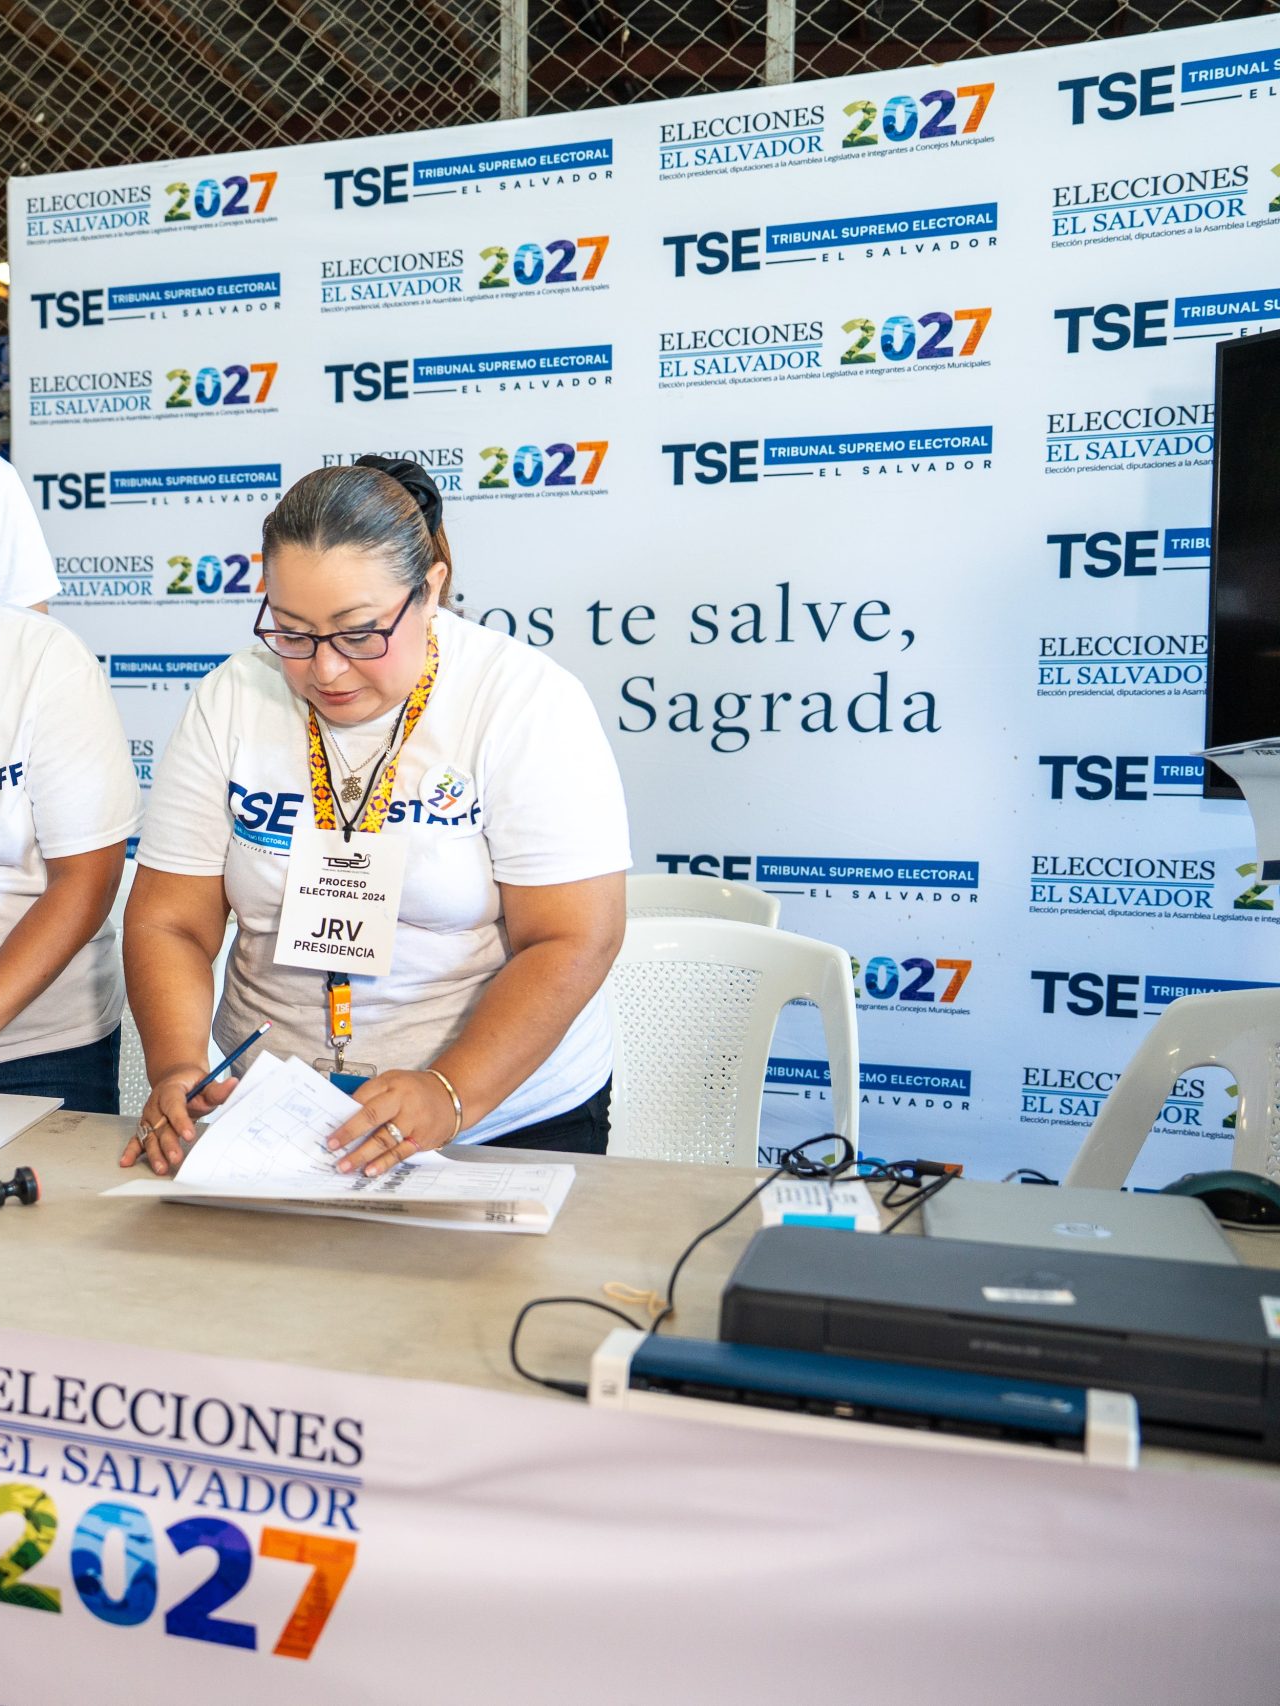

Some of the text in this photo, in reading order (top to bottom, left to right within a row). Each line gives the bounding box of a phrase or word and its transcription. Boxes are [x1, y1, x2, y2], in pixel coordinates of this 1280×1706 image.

[1189, 61, 1269, 82] TRIBUNAL
[1059, 67, 1174, 123] TSE
[1250, 86, 1276, 99] EL
[660, 105, 824, 143] ELECCIONES
[843, 84, 994, 147] 2027
[418, 148, 609, 178] TRIBUNAL SUPREMO ELECTORAL
[659, 172, 685, 180] Elección
[687, 167, 728, 178] presidencial,
[730, 163, 773, 173] diputaciones
[788, 157, 822, 166] Asamblea
[824, 153, 859, 162] Legislativa
[867, 147, 908, 157] integrantes
[915, 142, 949, 151] Concejos
[950, 136, 994, 146] Municipales
[660, 135, 823, 170] EL SALVADOR
[325, 165, 409, 210] TSE
[462, 170, 612, 194] EL SALVADOR
[1053, 165, 1248, 207] ELECCIONES
[27, 185, 151, 214] ELECCIONES
[165, 173, 277, 221] 2027
[27, 210, 150, 236] EL SALVADOR
[771, 213, 993, 244] TRIBUNAL SUPREMO ELECTORAL
[1053, 198, 1246, 236] EL SALVADOR
[480, 237, 608, 288] 2027
[664, 230, 759, 275] TSE
[822, 236, 997, 262] EL SALVADOR
[322, 249, 463, 278] ELECCIONES
[112, 281, 277, 303] TRIBUNAL SUPREMO ELECTORAL
[322, 276, 462, 303] EL SALVADOR
[31, 290, 104, 329] TSE
[150, 301, 280, 320] EL SALVADOR
[1181, 301, 1259, 318] TRIBUNAL
[660, 321, 823, 351] ELECCIONES
[841, 309, 991, 363] 2027
[1055, 301, 1167, 352] TSE
[418, 354, 608, 375] TRIBUNAL SUPREMO ELECTORAL
[660, 350, 822, 377] EL SALVADOR
[30, 370, 152, 393] ELECCIONES
[166, 364, 277, 407] 2027
[325, 361, 409, 403] TSE
[462, 376, 611, 393] EL SALVADOR
[30, 395, 151, 416] EL SALVADOR
[769, 436, 987, 457] TRIBUNAL SUPREMO ELECTORAL
[1046, 444, 1078, 462] EL
[479, 442, 607, 487] 2027
[663, 442, 757, 483] TSE
[819, 460, 991, 477] EL SALVADOR
[34, 472, 106, 510] TSE
[114, 470, 277, 487] TRIBUNAL SUPREMO ELECTORAL
[151, 492, 284, 506] EL SALVADOR
[1046, 530, 1158, 579] TSE
[586, 600, 655, 645] te
[690, 583, 914, 651] salve,
[115, 662, 215, 672] TRIBUNAL SUPREMO
[1038, 667, 1070, 685] EL
[619, 671, 941, 750] Sagrada
[1038, 755, 1148, 799] TSE
[762, 865, 974, 880] TRIBUNAL SUPREMO ELECTORAL
[1031, 856, 1215, 880] ELECCIONES
[300, 887, 386, 902] ELECTORAL 2024
[319, 877, 367, 889] PROCESO
[810, 888, 977, 903] EL SALVADOR
[1030, 885, 1213, 908] EL SALVADOR
[311, 918, 364, 942] JRV
[294, 940, 375, 959] PRESIDENCIA
[1031, 971, 1140, 1018] TSE
[891, 1074, 967, 1089] ELECTORAL
[62, 1444, 361, 1532] SALVADOR
